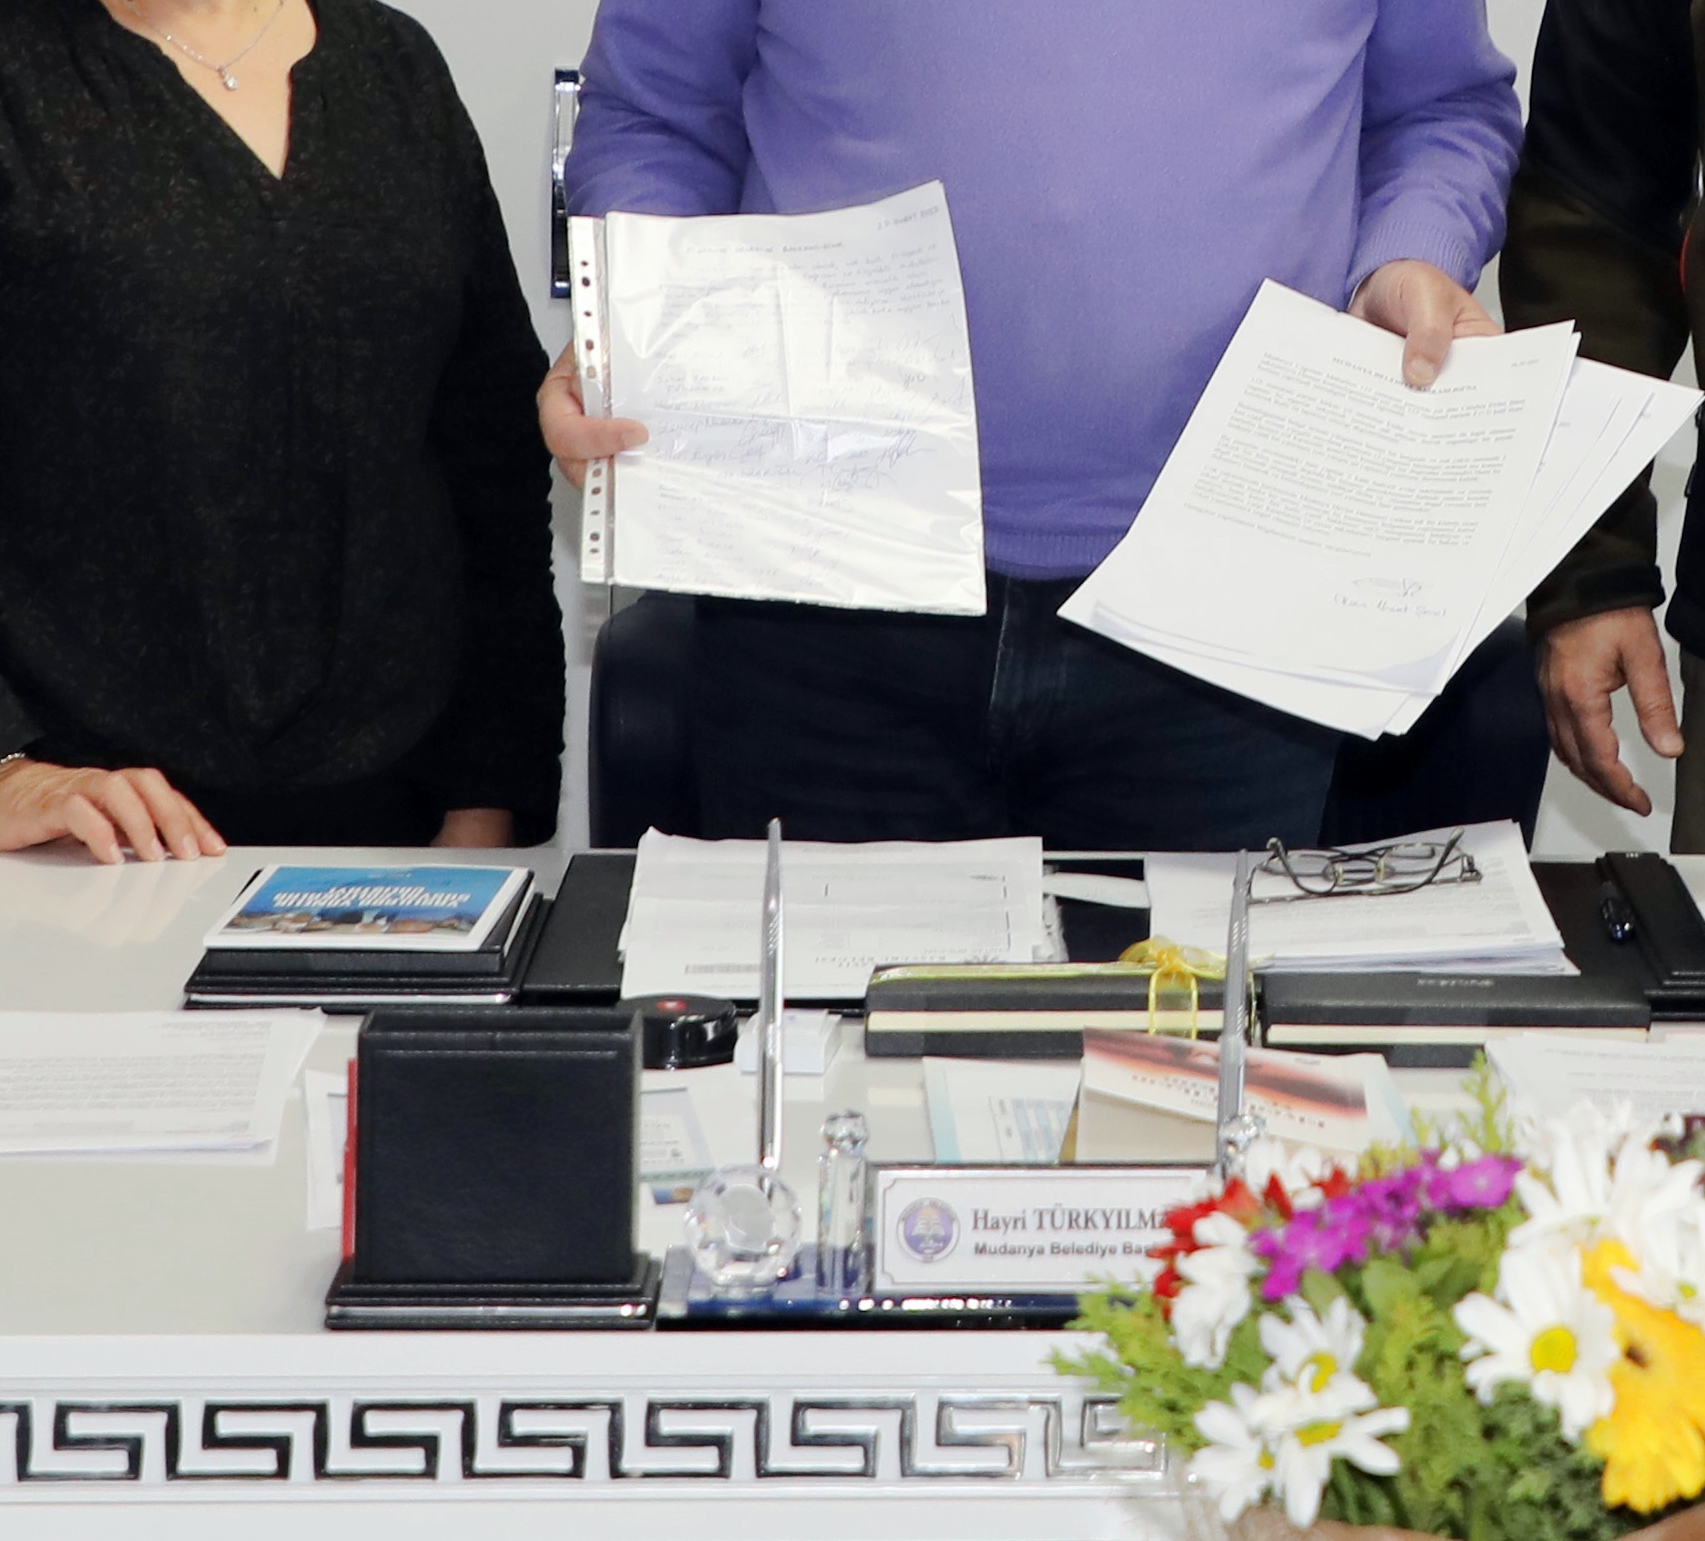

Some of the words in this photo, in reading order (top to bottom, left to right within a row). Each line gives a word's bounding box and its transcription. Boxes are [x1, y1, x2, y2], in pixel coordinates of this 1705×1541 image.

[972, 1208, 1026, 1236] Hayri
[1033, 1202, 1164, 1230] TÜRKYILM
[974, 1241, 1045, 1258] Mudanya
[1050, 1241, 1118, 1258] Belediye
